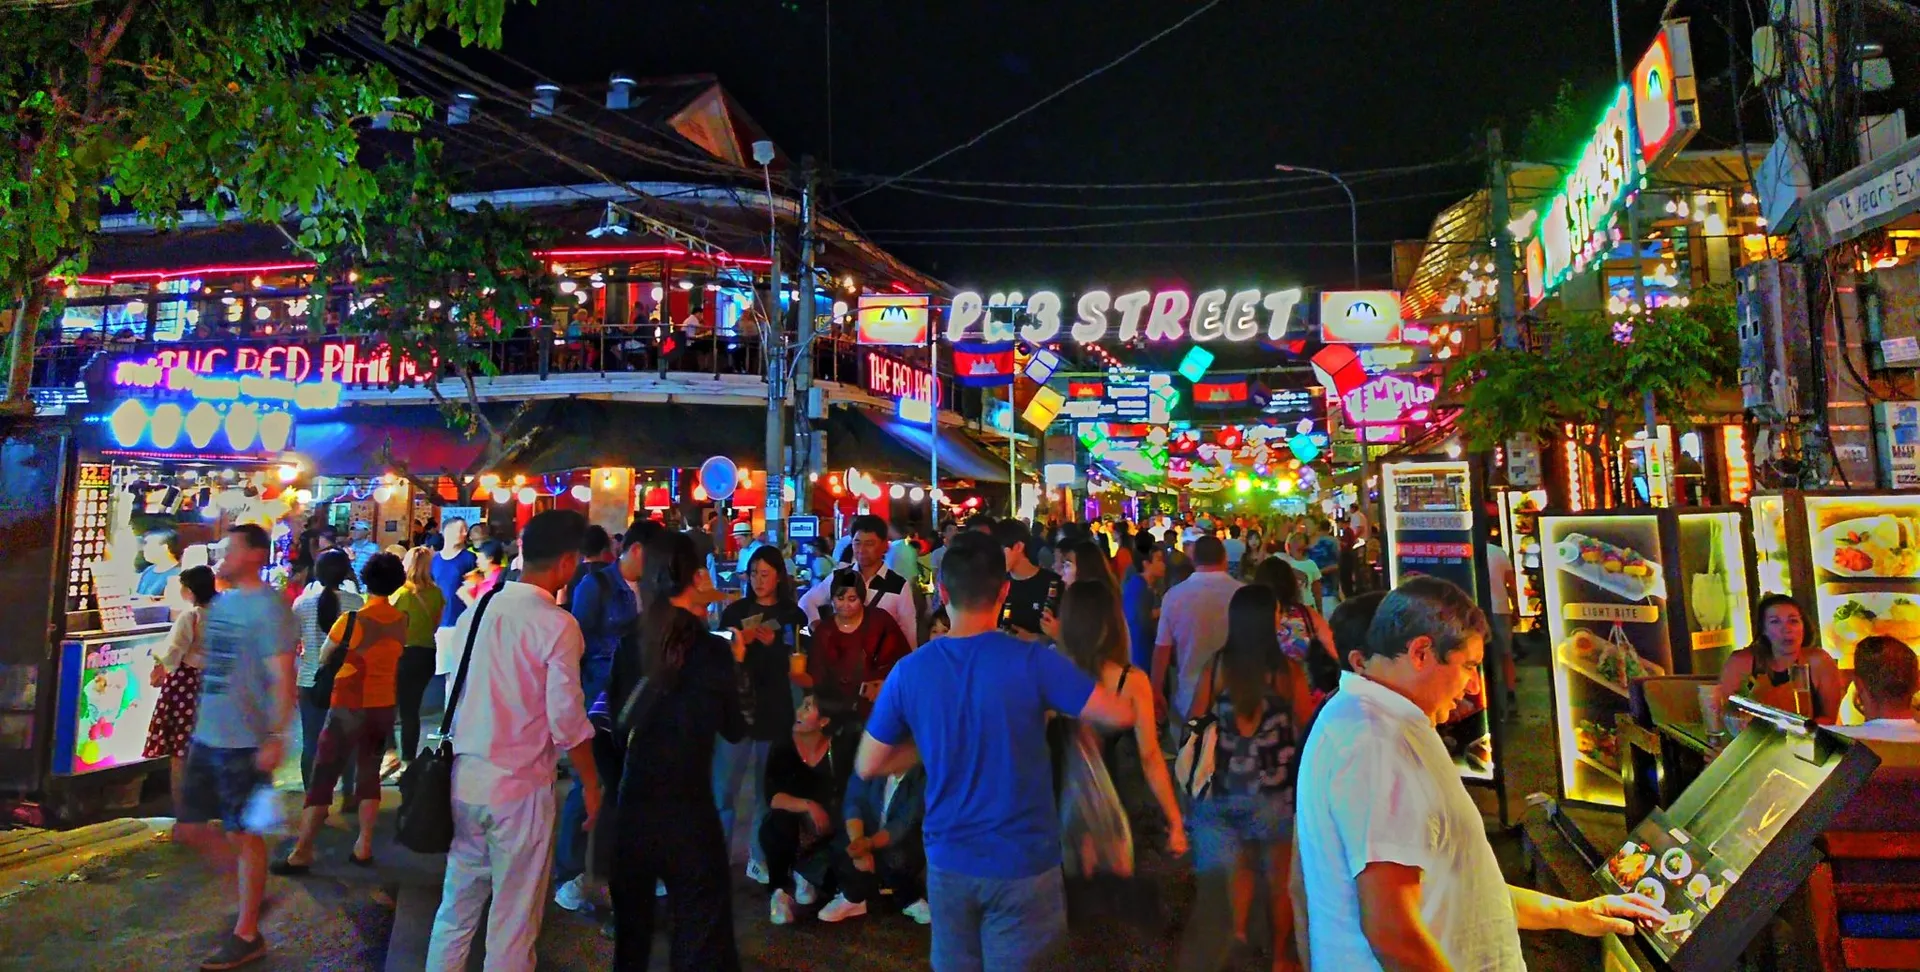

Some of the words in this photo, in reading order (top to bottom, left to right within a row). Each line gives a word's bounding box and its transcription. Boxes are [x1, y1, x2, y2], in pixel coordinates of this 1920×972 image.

[1894, 168, 1920, 196] Ex
[1071, 288, 1302, 342] STREET
[234, 346, 309, 383] RED
[868, 352, 892, 393] THE
[892, 361, 914, 398] RED
[1582, 607, 1610, 618] LIGHT
[1614, 608, 1638, 619] BITE
